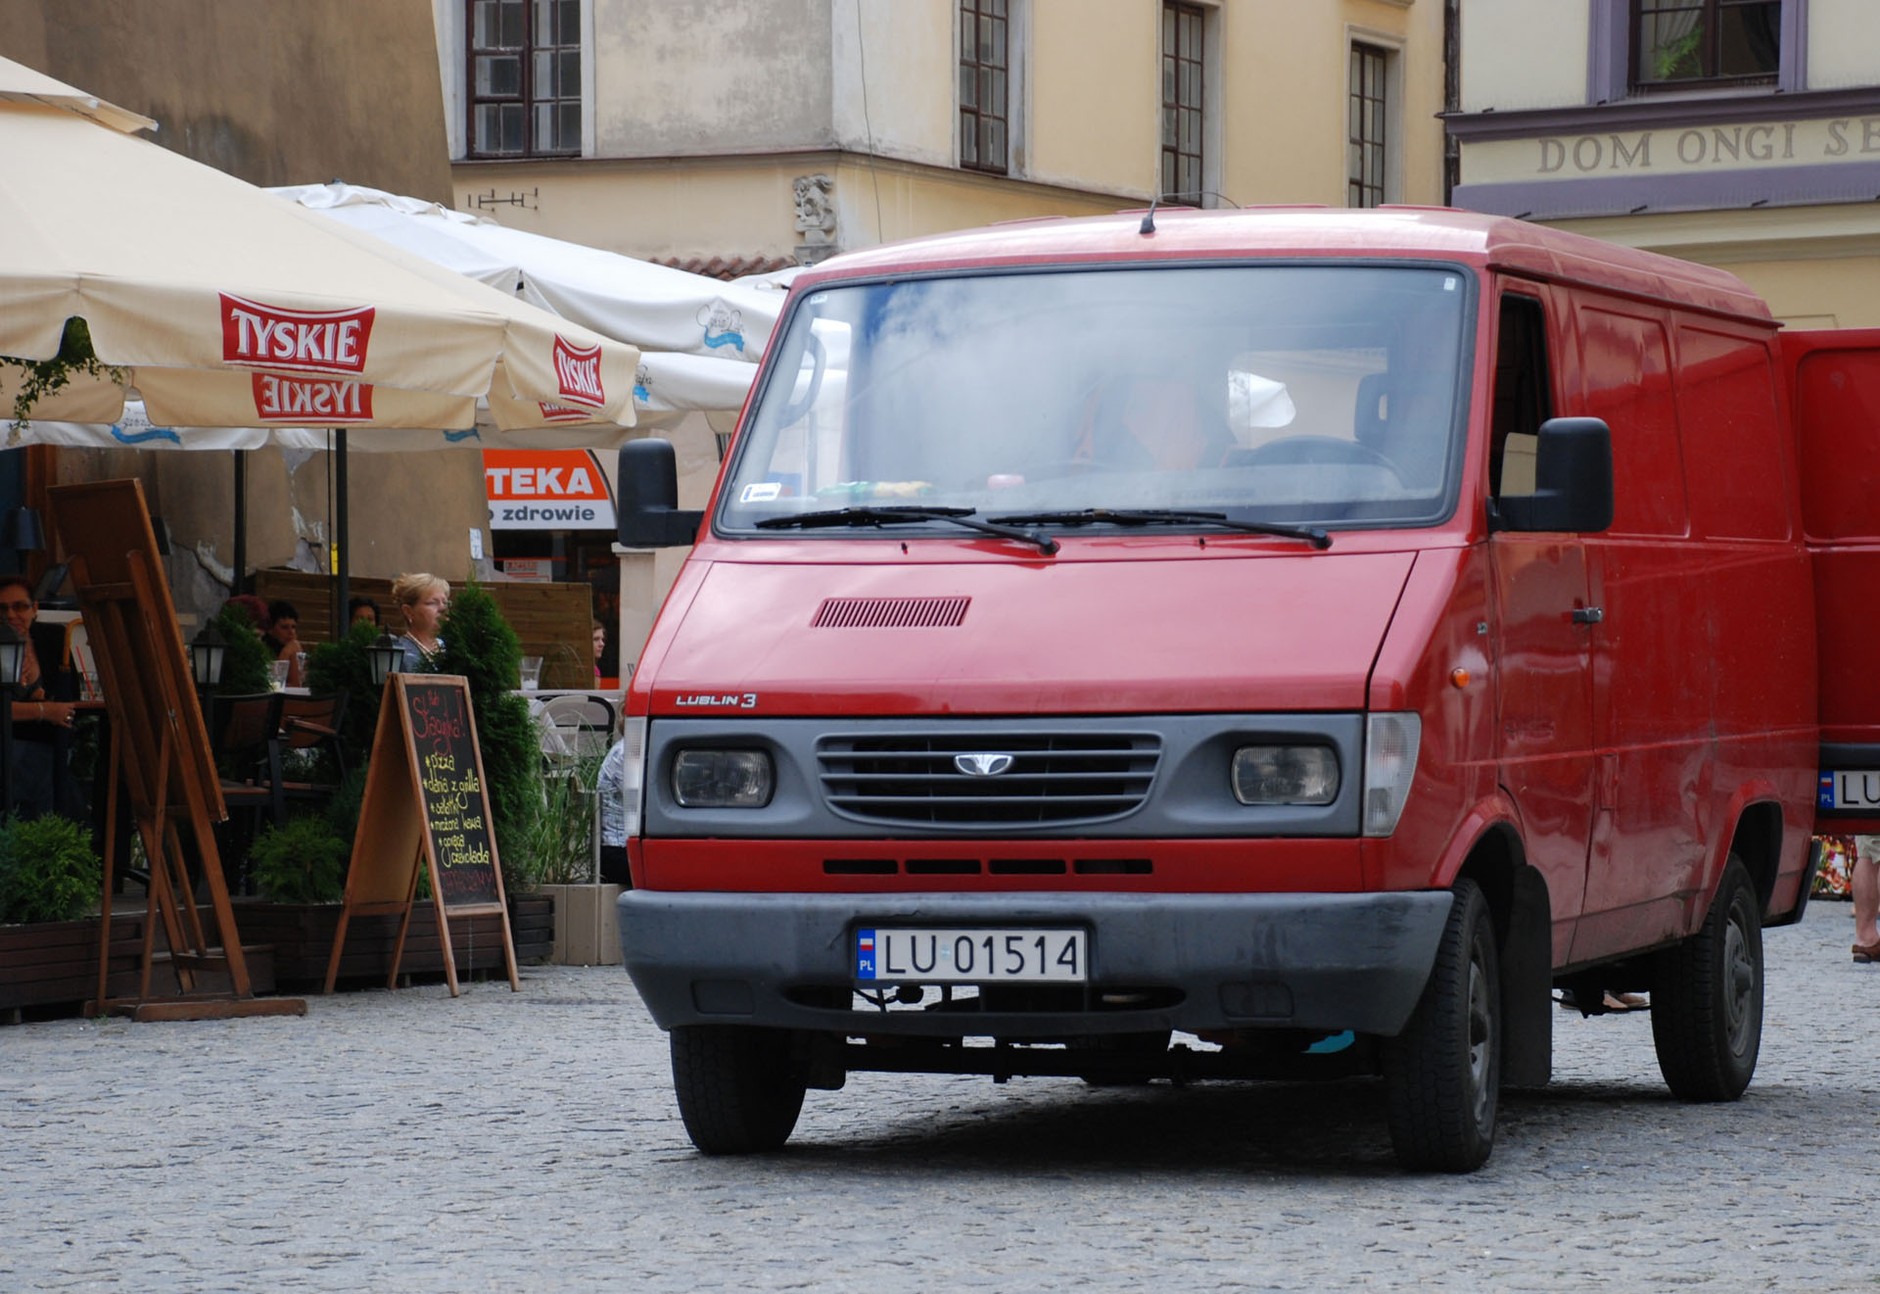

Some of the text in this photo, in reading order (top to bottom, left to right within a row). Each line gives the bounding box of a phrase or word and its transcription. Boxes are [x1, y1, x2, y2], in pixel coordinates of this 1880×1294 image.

[1537, 117, 1880, 173] DOM ONGI SE
[231, 307, 360, 366] TYSKIE
[556, 344, 602, 397] TYSKIE
[485, 467, 594, 495] TEKA
[502, 505, 595, 521] zdrowie
[676, 693, 757, 708] LUBLIN 3
[430, 752, 455, 780] pizza
[1821, 793, 1832, 803] PL
[1842, 774, 1880, 804] LU
[860, 960, 873, 971] PL
[885, 935, 1077, 975] LU 01514
